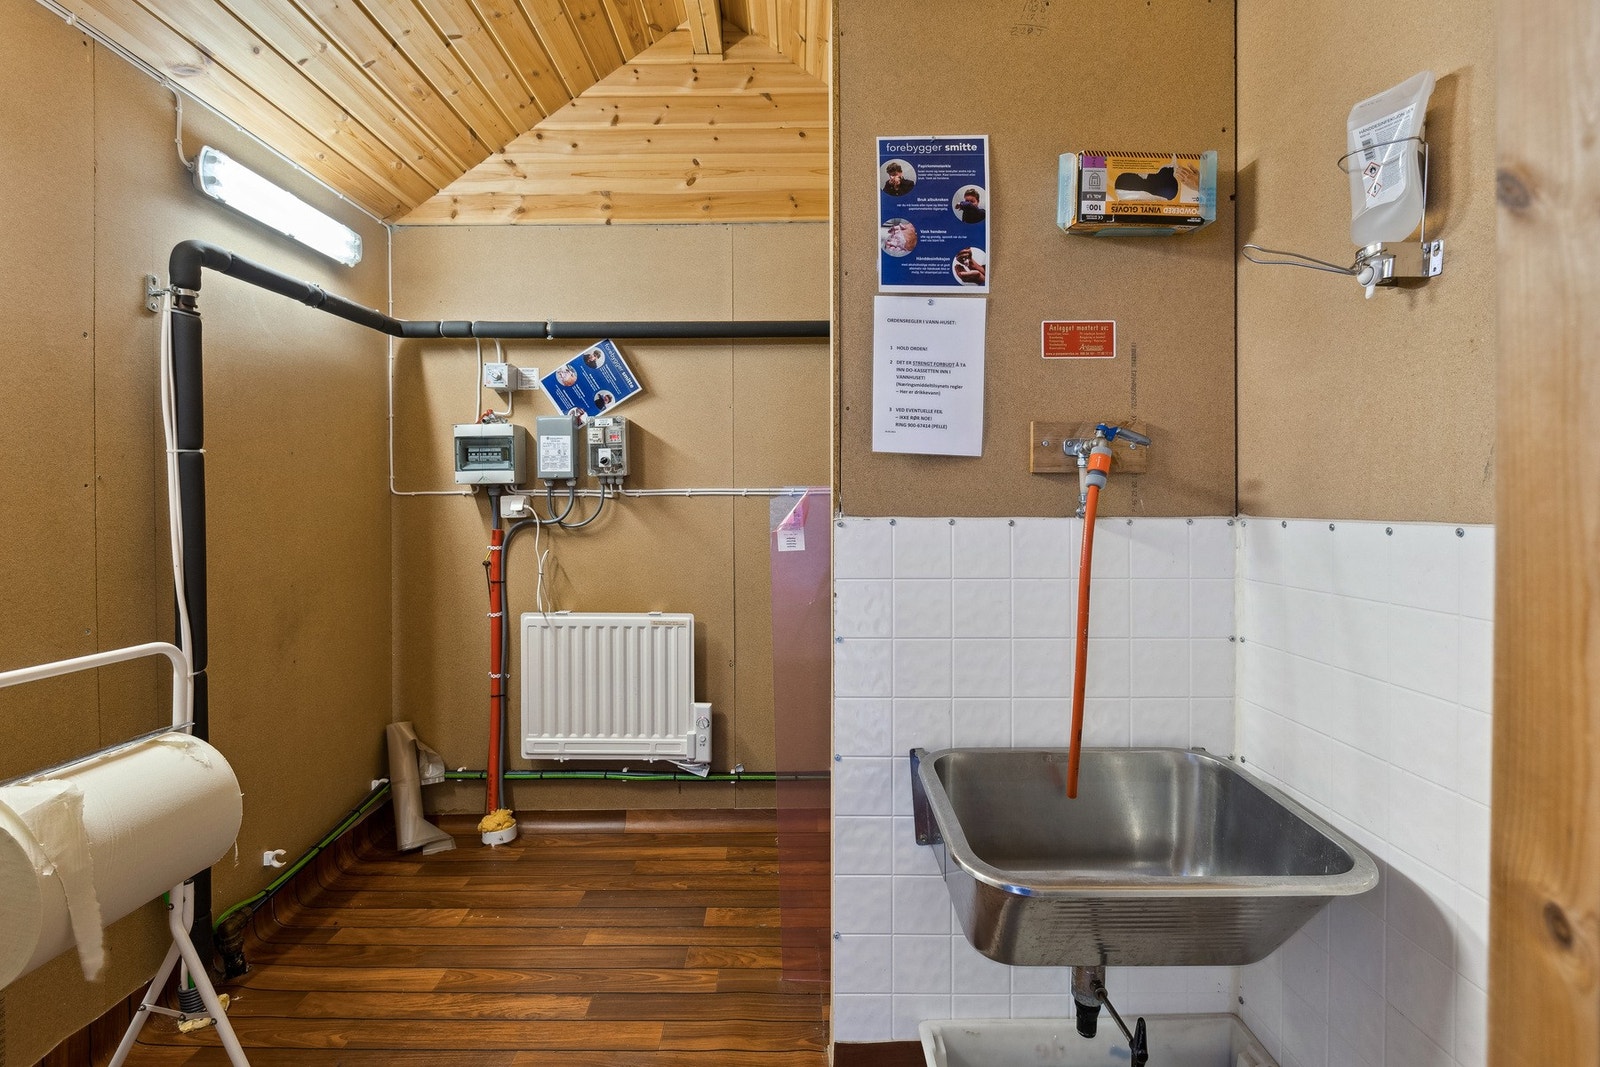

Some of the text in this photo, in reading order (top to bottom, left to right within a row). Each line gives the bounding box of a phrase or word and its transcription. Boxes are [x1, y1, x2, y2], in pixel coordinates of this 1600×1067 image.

[886, 142, 977, 154] forebygger smitte
[1049, 324, 1074, 332] Anlegget
[604, 343, 623, 372] forebygger
[622, 372, 634, 388] smitte
